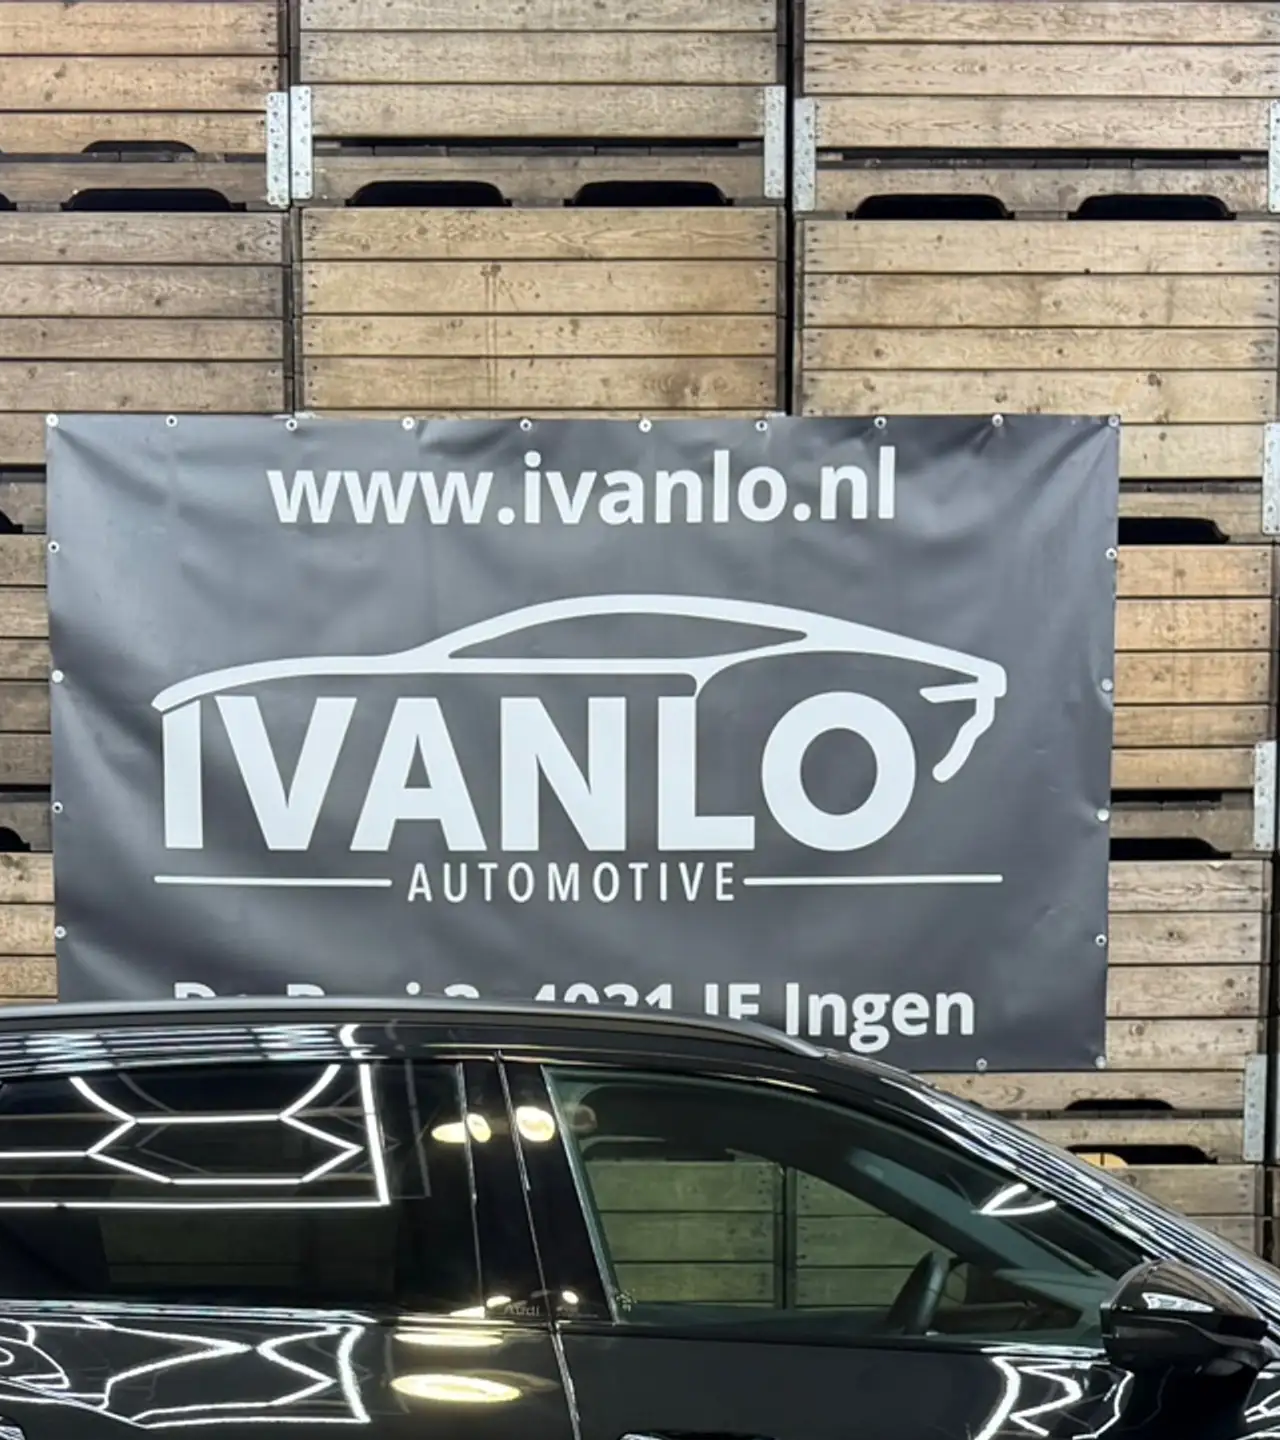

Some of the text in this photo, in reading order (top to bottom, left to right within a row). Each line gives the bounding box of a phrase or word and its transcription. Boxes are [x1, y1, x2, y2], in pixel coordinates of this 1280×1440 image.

[266, 446, 896, 526] www.ivanlo.nl
[161, 690, 917, 852] IVANLO
[406, 861, 736, 904] AUTOMOTIVE
[785, 982, 975, 1054] Ingen
